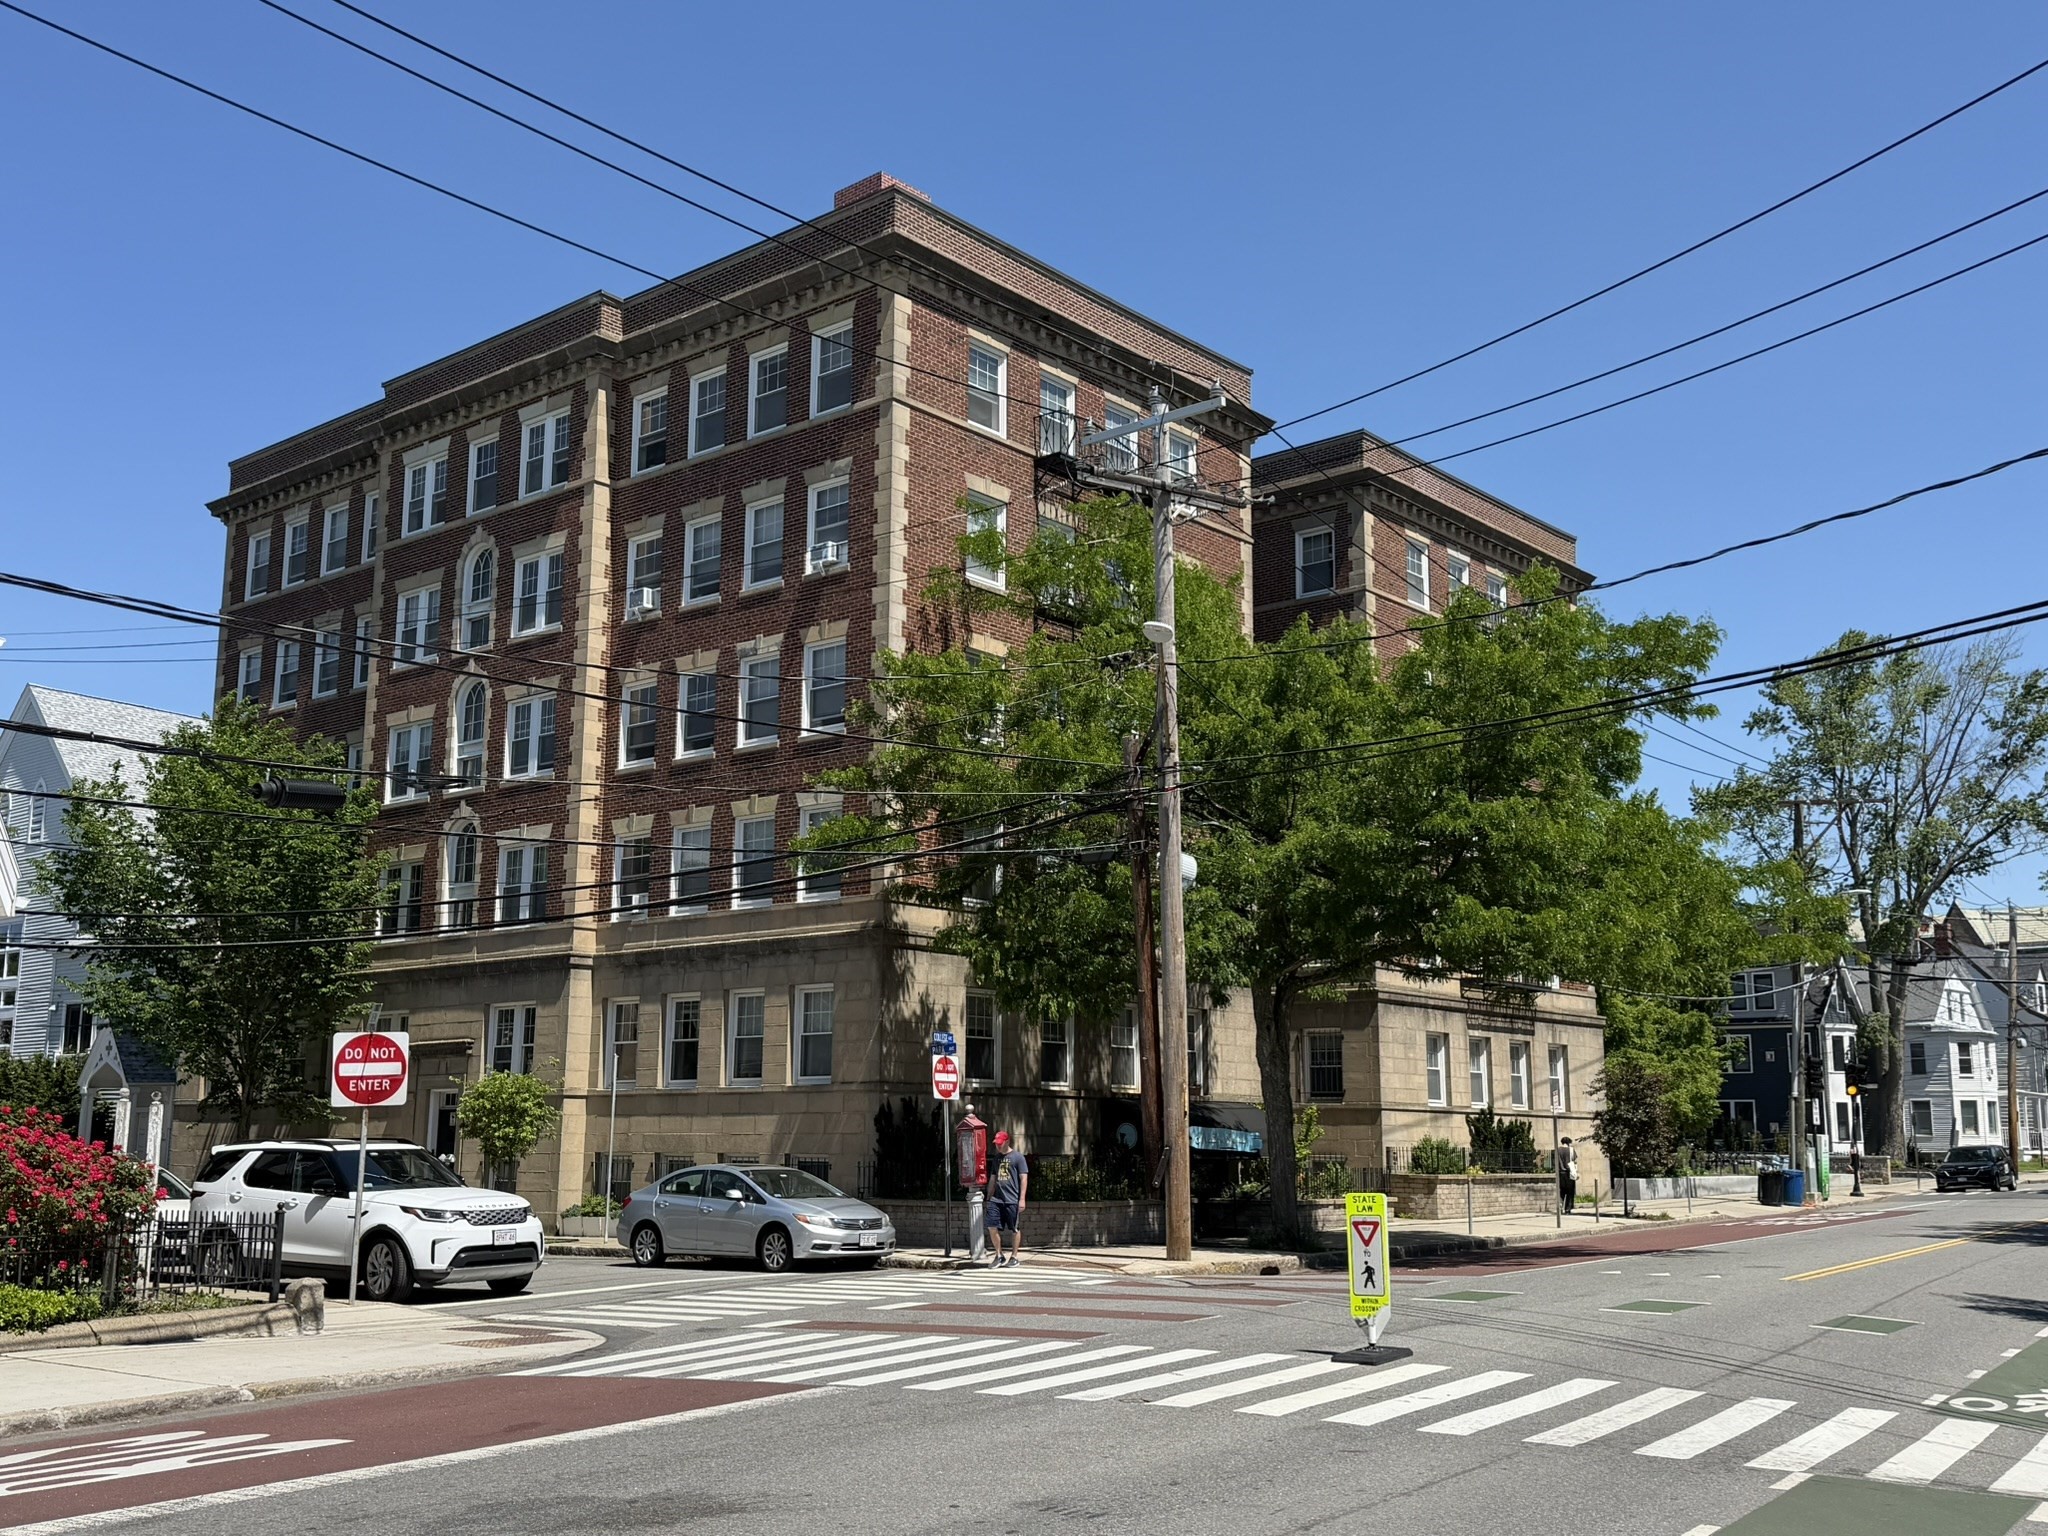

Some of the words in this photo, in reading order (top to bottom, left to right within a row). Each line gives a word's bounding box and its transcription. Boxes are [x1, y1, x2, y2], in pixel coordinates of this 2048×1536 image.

[345, 1047, 362, 1060] DO
[370, 1047, 396, 1059] NOT
[936, 1063, 943, 1071] DO
[349, 1079, 390, 1092] ENTER
[938, 1083, 954, 1091] ENTER
[1352, 1195, 1377, 1203] STATE
[1356, 1205, 1373, 1213] LAW
[1354, 1304, 1381, 1312] CROSSWA
